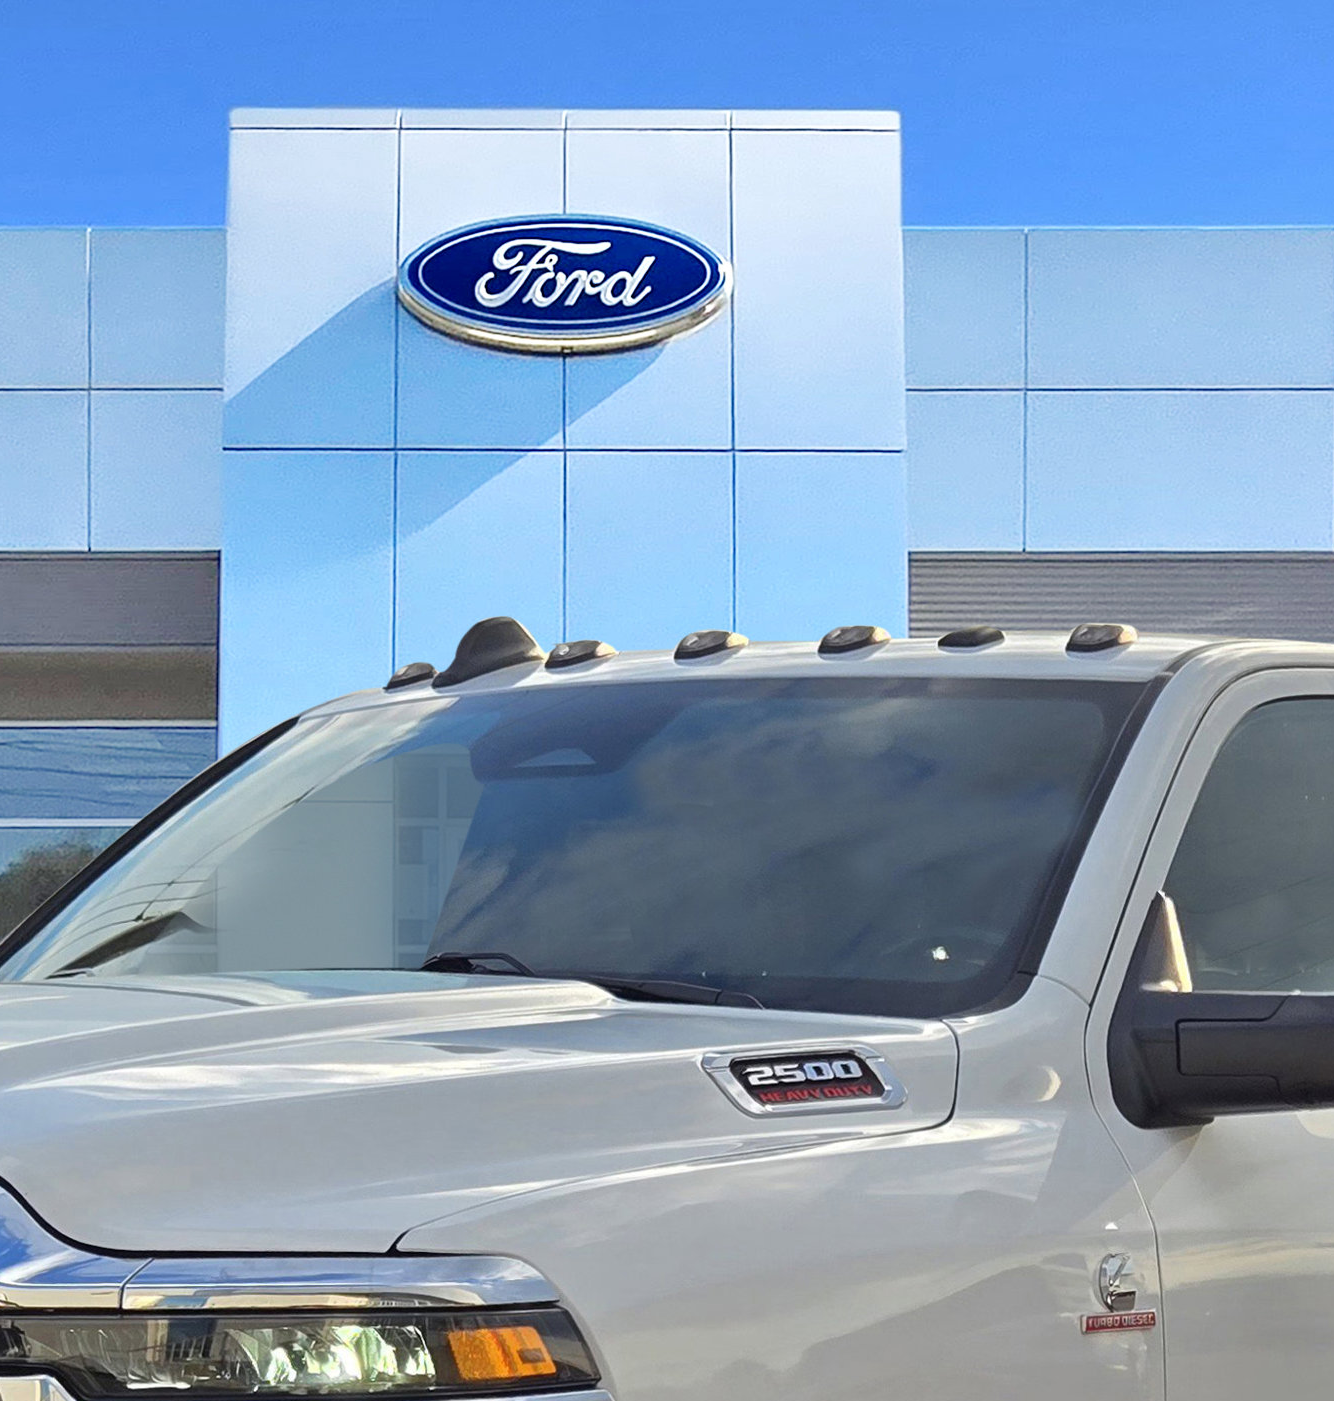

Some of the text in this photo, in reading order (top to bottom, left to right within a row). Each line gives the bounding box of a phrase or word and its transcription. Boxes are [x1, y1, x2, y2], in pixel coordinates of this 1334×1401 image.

[474, 237, 657, 309] Ford
[741, 1059, 865, 1087] 2500
[758, 1084, 874, 1104] HEAVY DUTY
[1087, 1312, 1155, 1329] TURBO DIESEL
